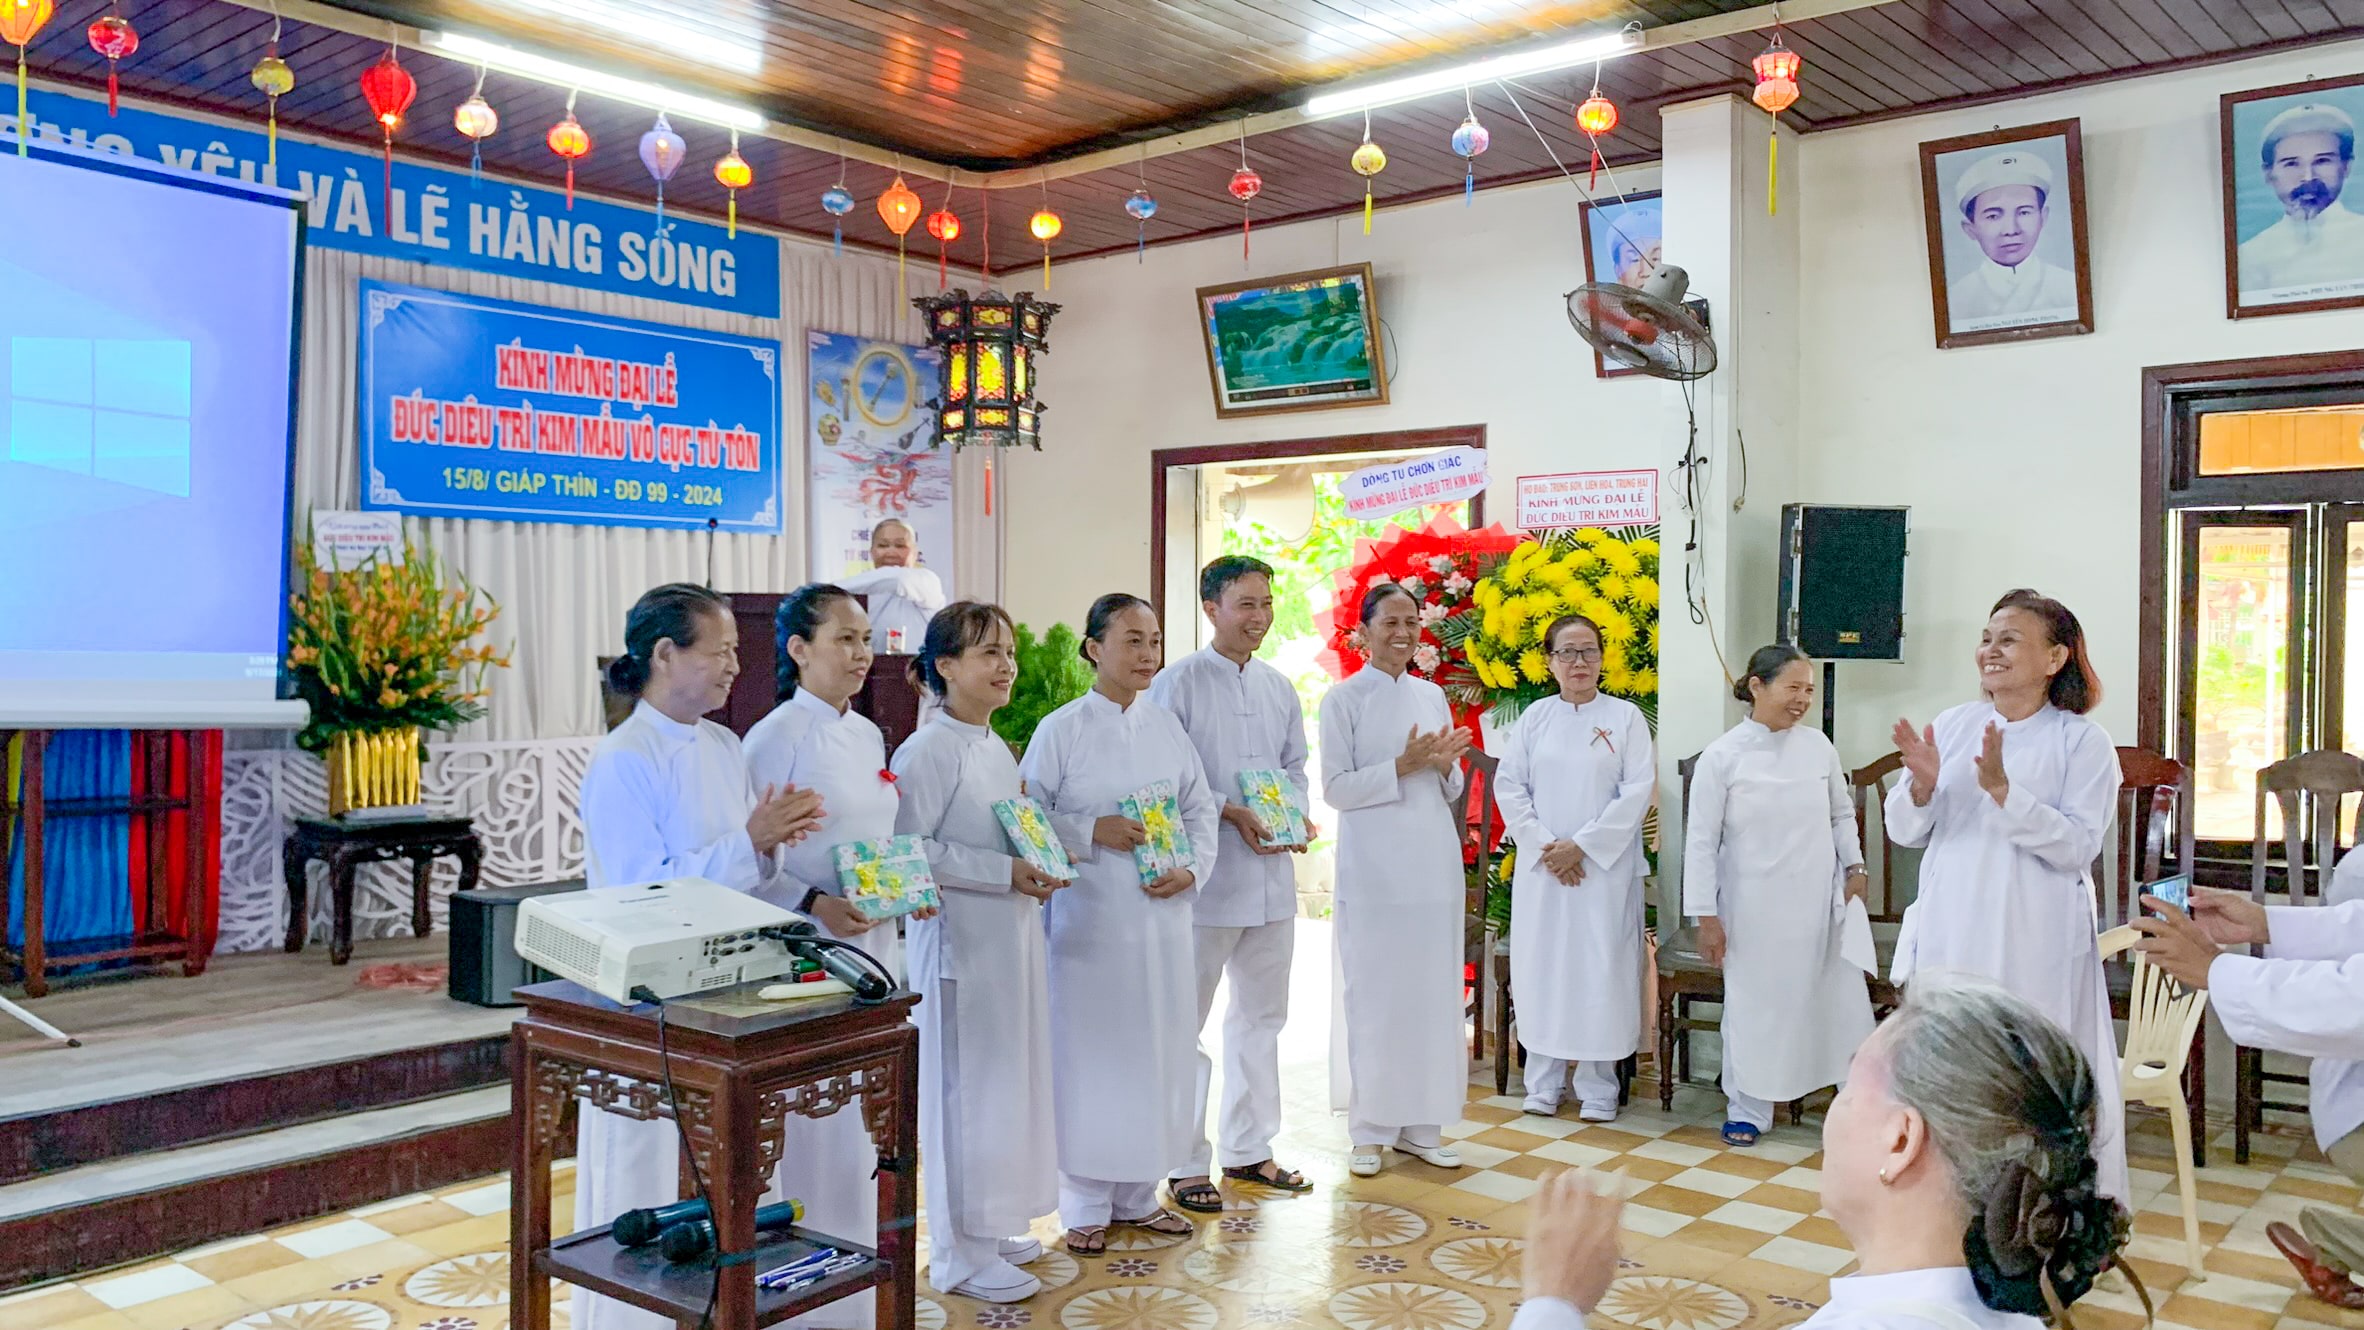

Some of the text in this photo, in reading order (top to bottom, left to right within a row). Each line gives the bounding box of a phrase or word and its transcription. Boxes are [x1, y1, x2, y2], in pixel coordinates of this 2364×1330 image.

[298, 167, 373, 237] VÀ
[391, 184, 450, 250] LẼ
[469, 190, 602, 275] HẰNG
[618, 222, 736, 297] SỐNG
[496, 337, 678, 411] KÍNH MỪNG ĐẠI LỄ
[391, 387, 440, 446] ĐỨC
[441, 394, 495, 449] DIÊU
[495, 399, 535, 453] TRÌ
[535, 409, 579, 457] KIM
[629, 413, 655, 462] VÔ
[657, 423, 694, 472] CỰC
[694, 418, 721, 468] TỪ
[722, 423, 761, 472] TÔN
[443, 467, 490, 491] 15/8/
[495, 468, 546, 494] GIÁP
[552, 471, 597, 498] THÌN
[614, 478, 642, 501] ĐĐ
[647, 482, 668, 503] 99
[683, 484, 723, 506] 2024
[1598, 509, 1619, 519] KIM
